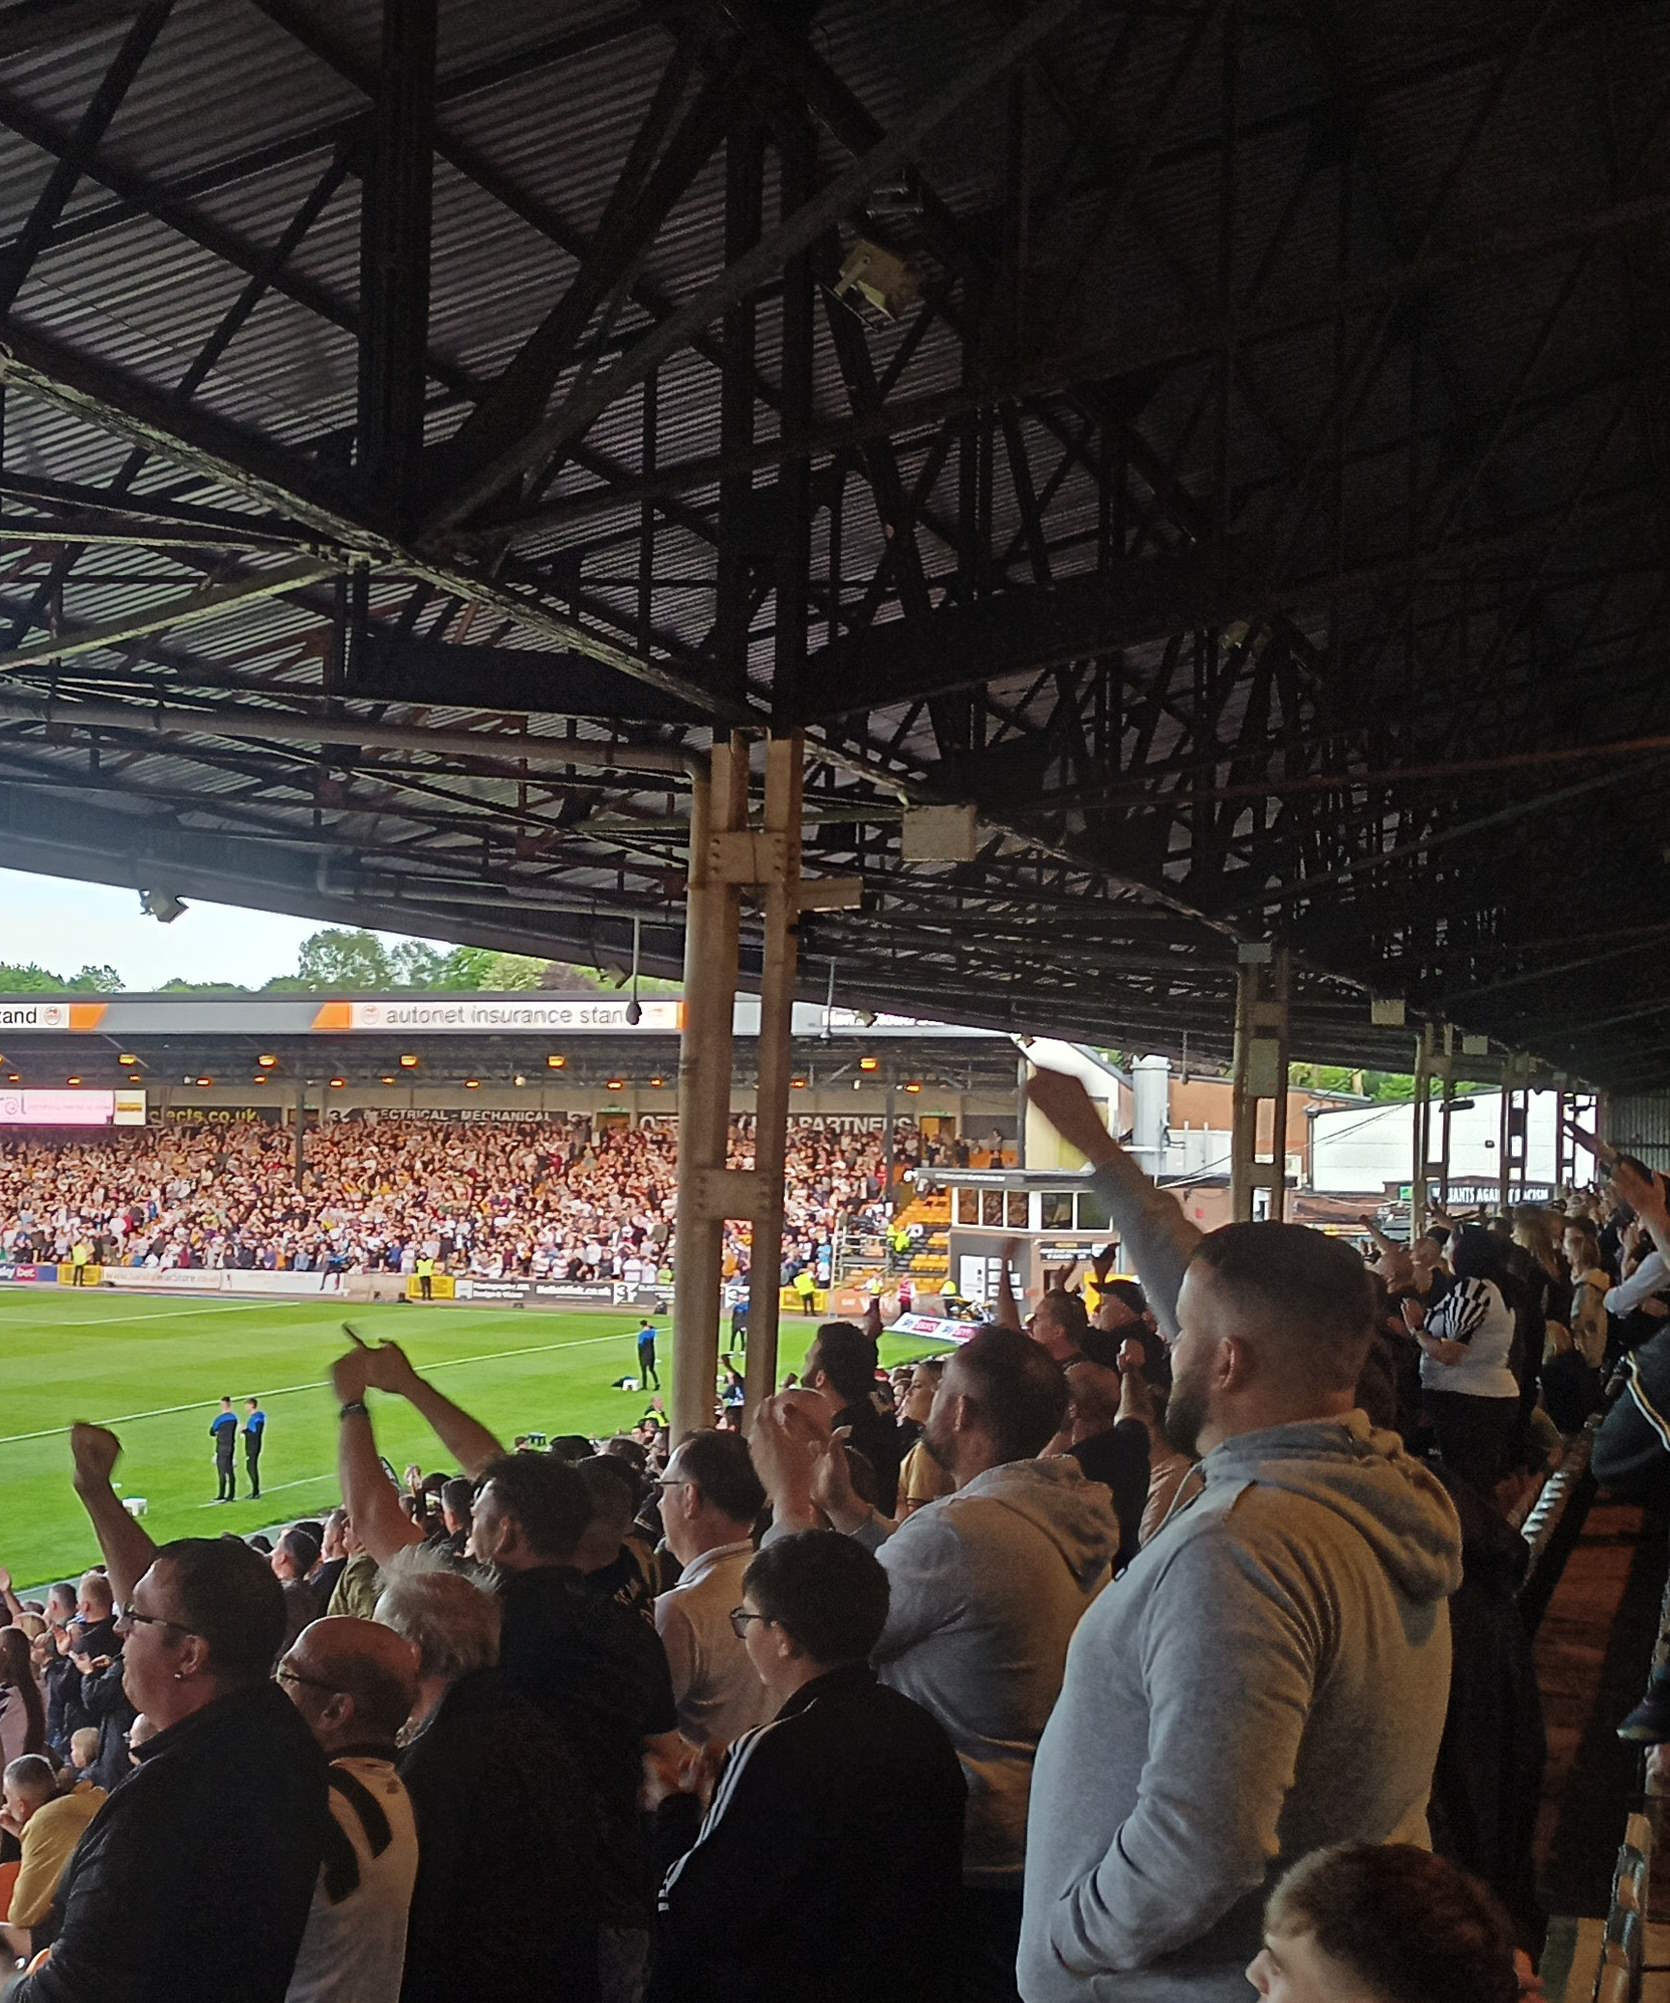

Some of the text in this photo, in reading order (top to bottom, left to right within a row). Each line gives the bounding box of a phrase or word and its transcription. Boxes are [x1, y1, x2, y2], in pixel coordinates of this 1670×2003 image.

[0, 1007, 37, 1024] and
[386, 1006, 625, 1024] autonet insurance stan
[363, 1109, 449, 1120] ECTRICAL
